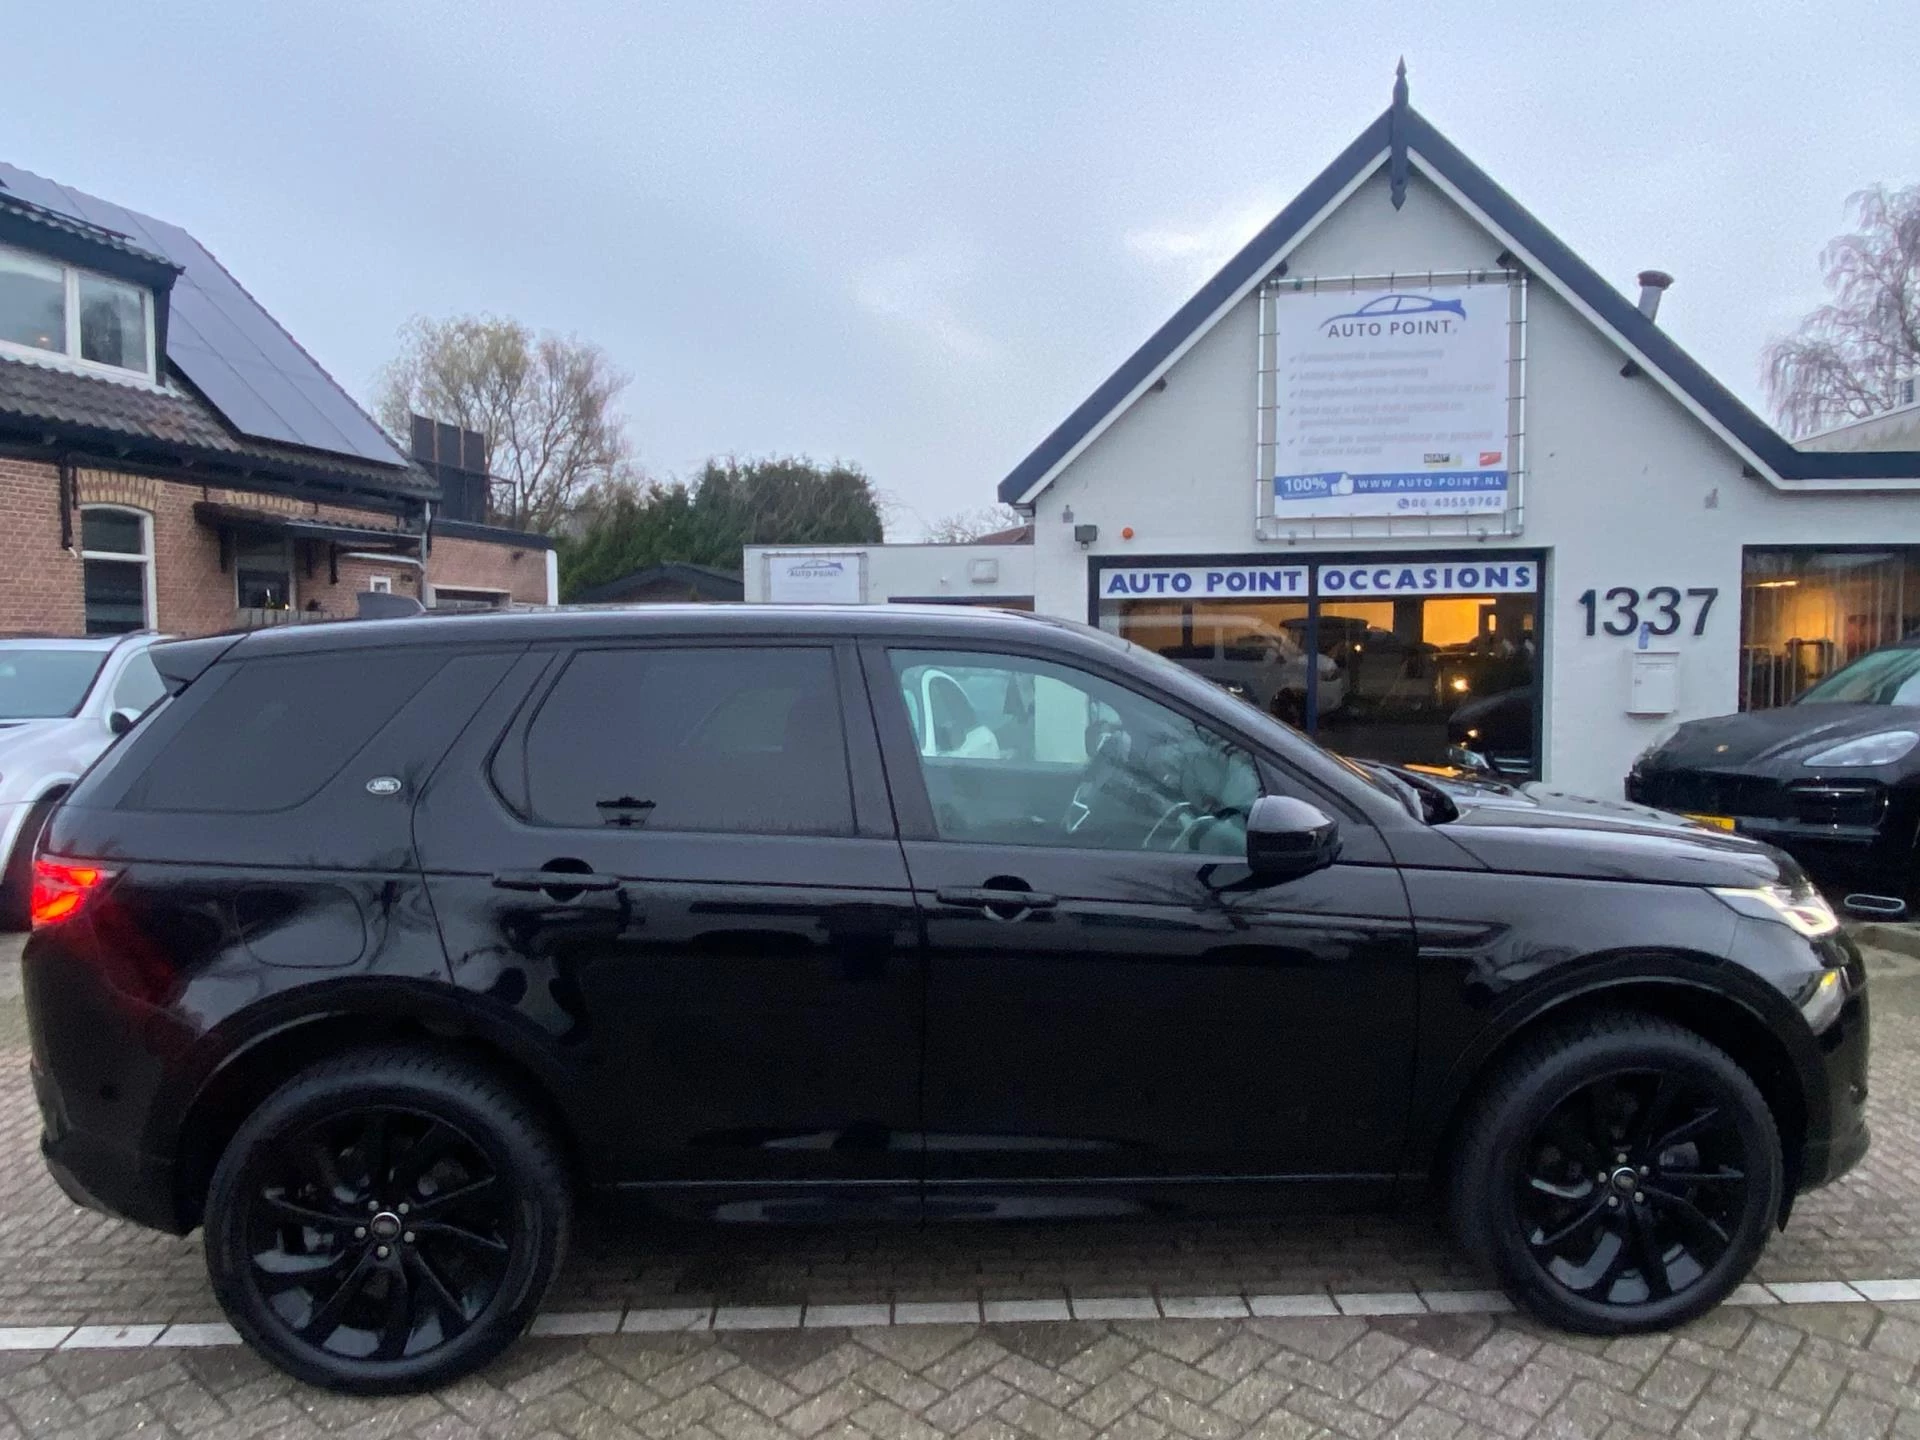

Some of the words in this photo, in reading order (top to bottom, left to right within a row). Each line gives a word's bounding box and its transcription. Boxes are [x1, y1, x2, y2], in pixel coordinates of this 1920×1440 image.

[1328, 322, 1382, 339] AUTO
[1284, 476, 1328, 492] 100%
[790, 569, 812, 577] AUTO
[1106, 573, 1193, 593] AUTO
[1206, 571, 1303, 592] POINT
[1323, 566, 1531, 591] OCCASIONS
[1578, 586, 1719, 637] 1337
